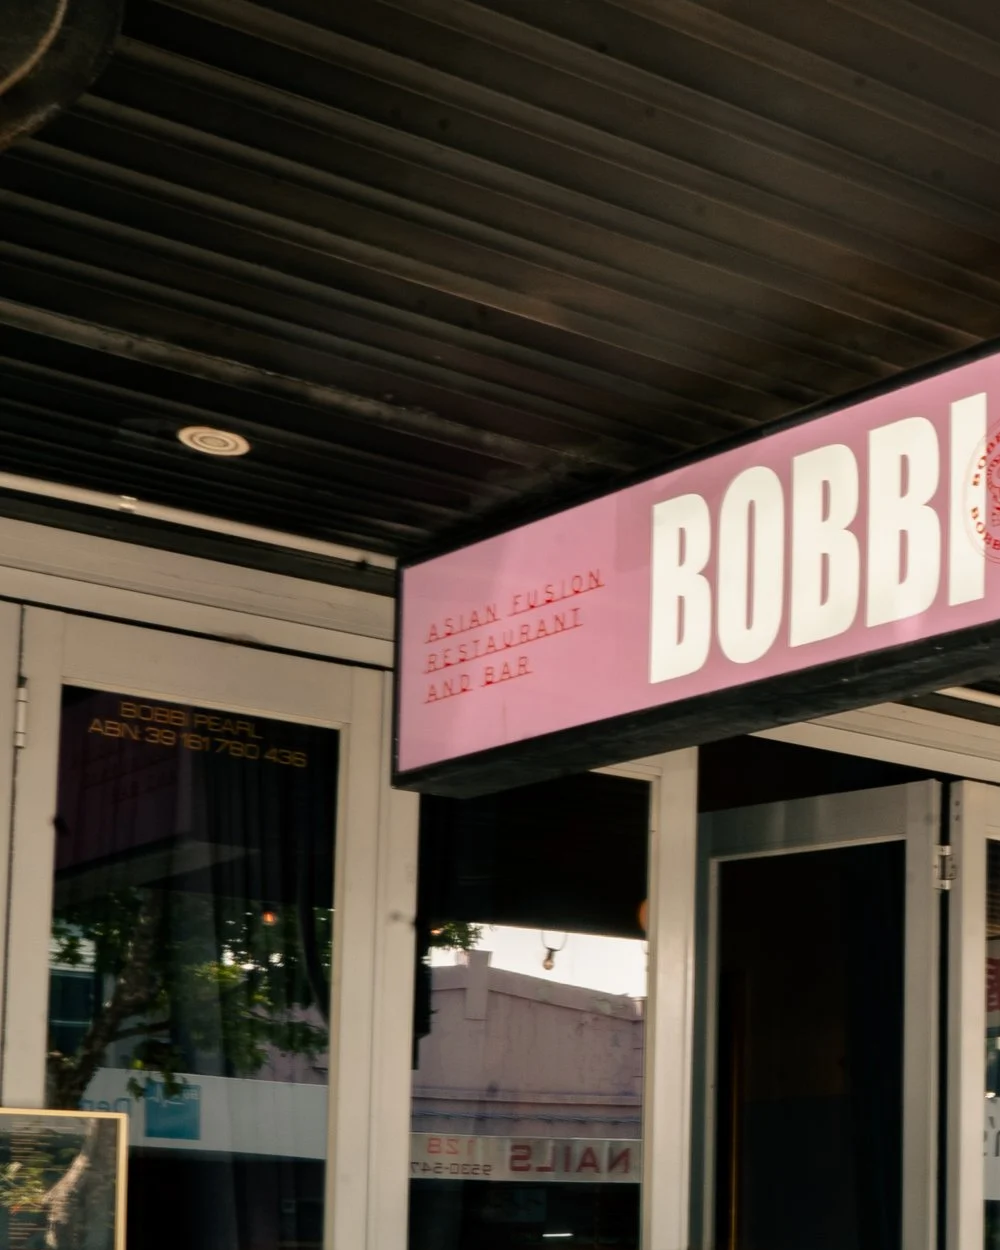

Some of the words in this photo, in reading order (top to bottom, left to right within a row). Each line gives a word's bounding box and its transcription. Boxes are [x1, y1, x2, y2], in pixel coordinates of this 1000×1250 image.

[650, 392, 987, 684] BOBBI
[425, 604, 500, 643] ASIAN
[508, 569, 605, 616] FUSION
[423, 608, 584, 674] RESTAURANT
[424, 673, 473, 704] AND
[481, 655, 532, 686] BAR
[119, 701, 189, 727] BOBBI
[193, 713, 264, 739] PEARL
[144, 726, 176, 747] 39
